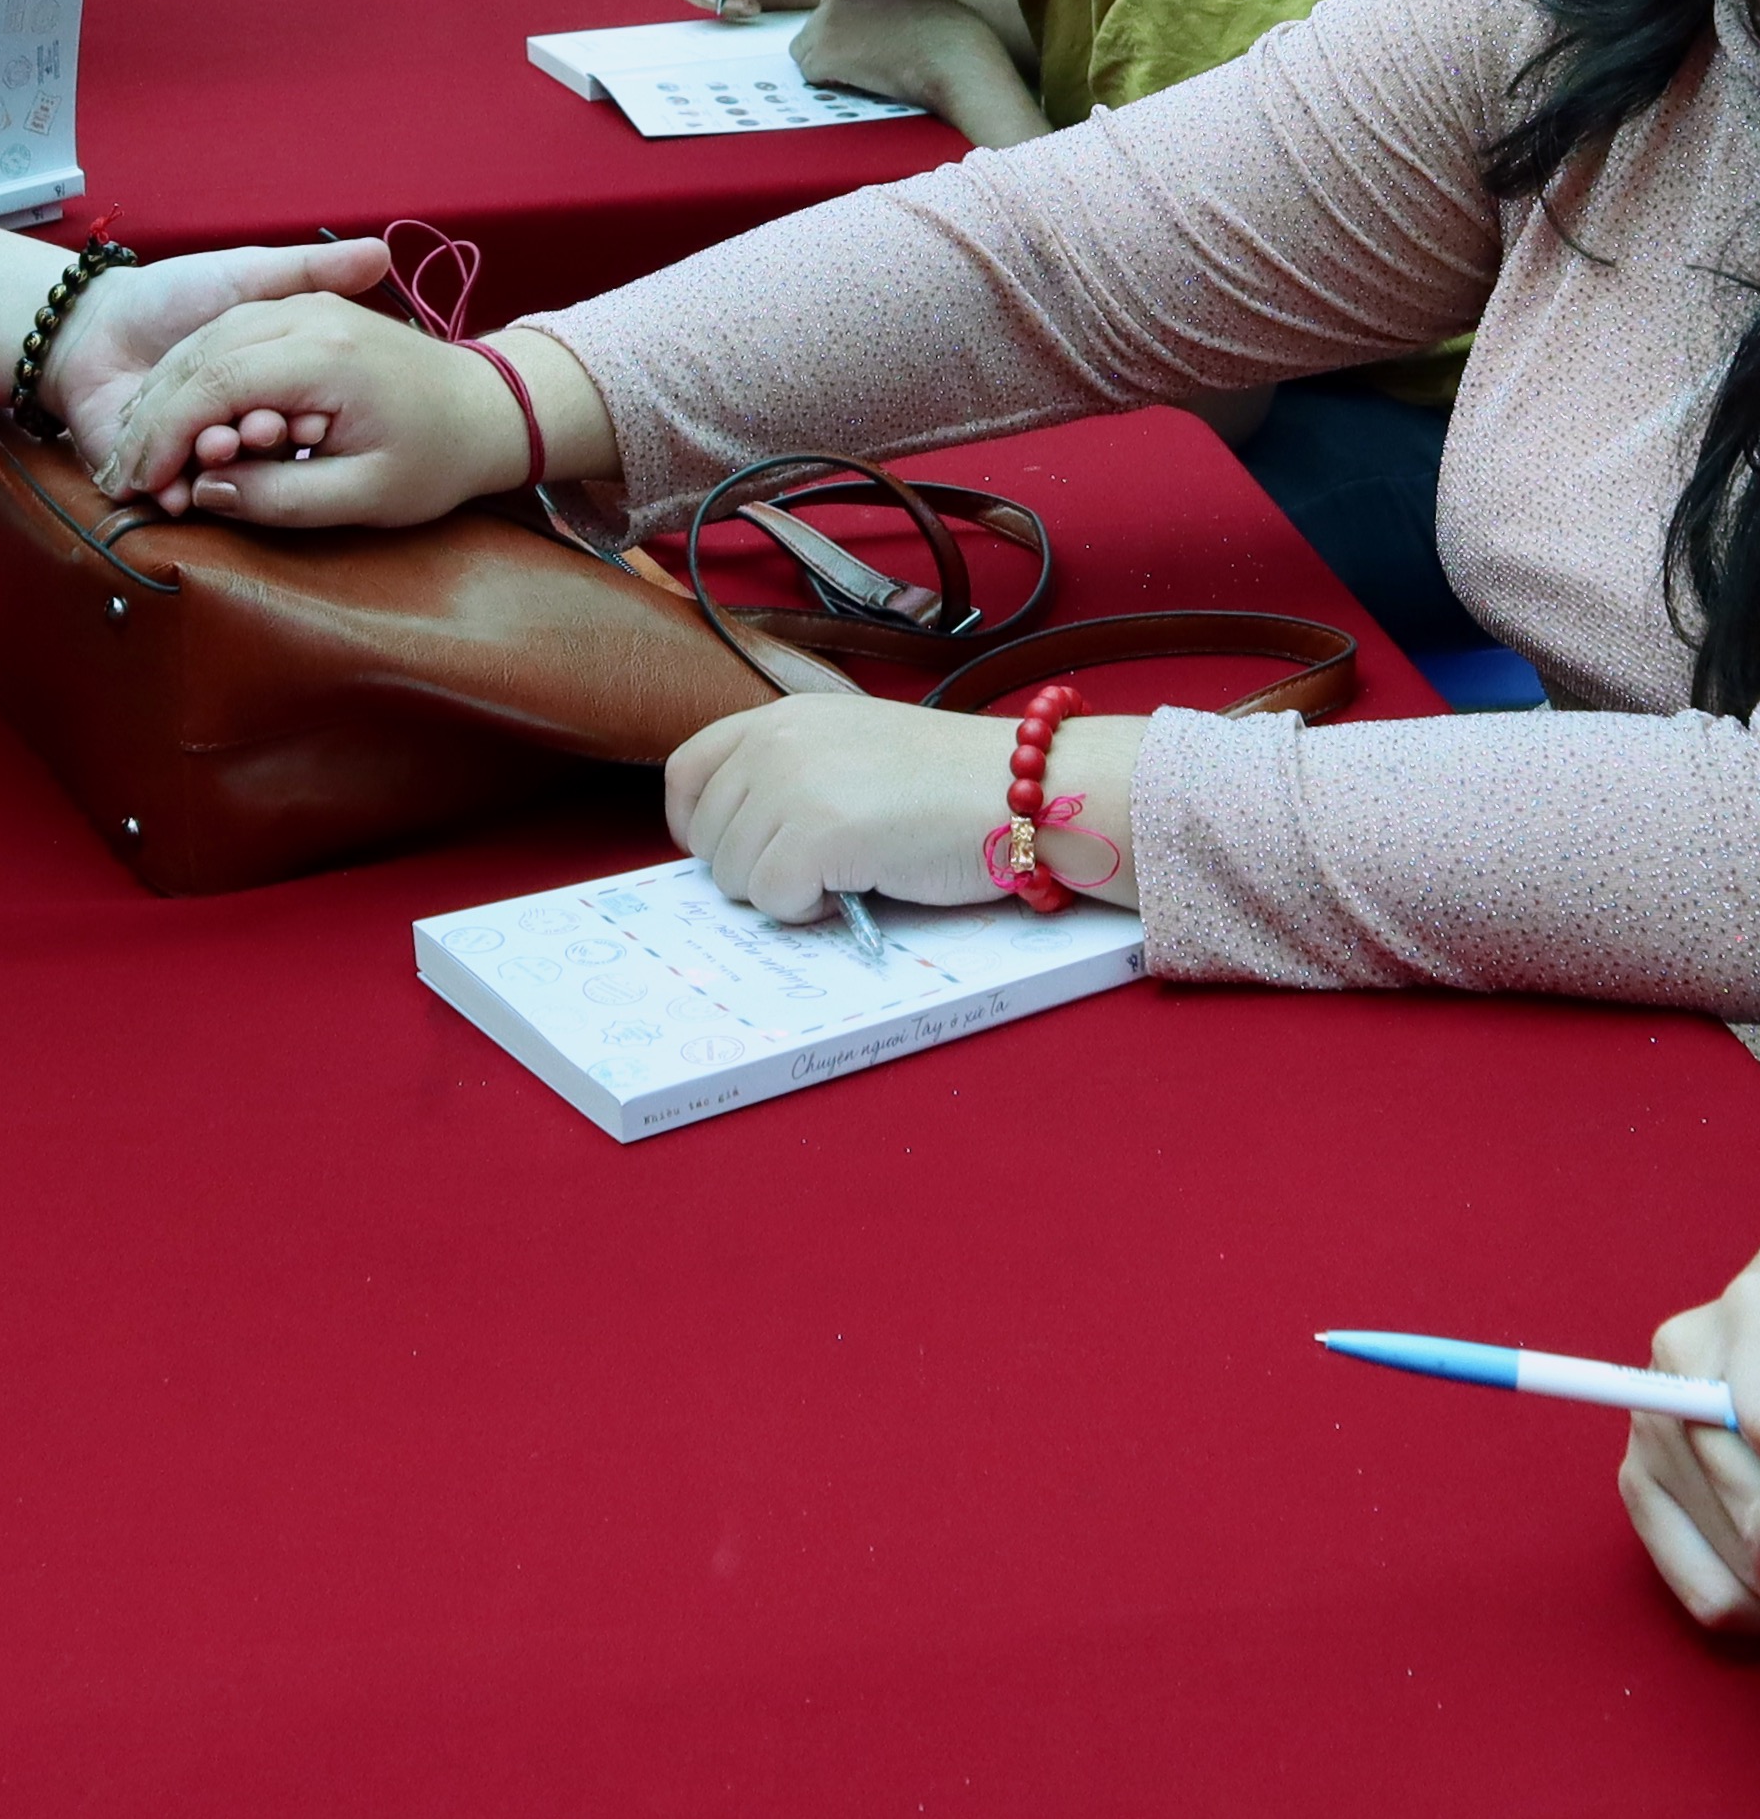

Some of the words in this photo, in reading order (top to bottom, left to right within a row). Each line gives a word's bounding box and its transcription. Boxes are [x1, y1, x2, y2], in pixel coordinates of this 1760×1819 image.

[791, 1049, 855, 1081] Chuyện
[860, 1028, 909, 1060] người
[911, 1013, 945, 1043] Tây
[986, 989, 1009, 1016] Ta
